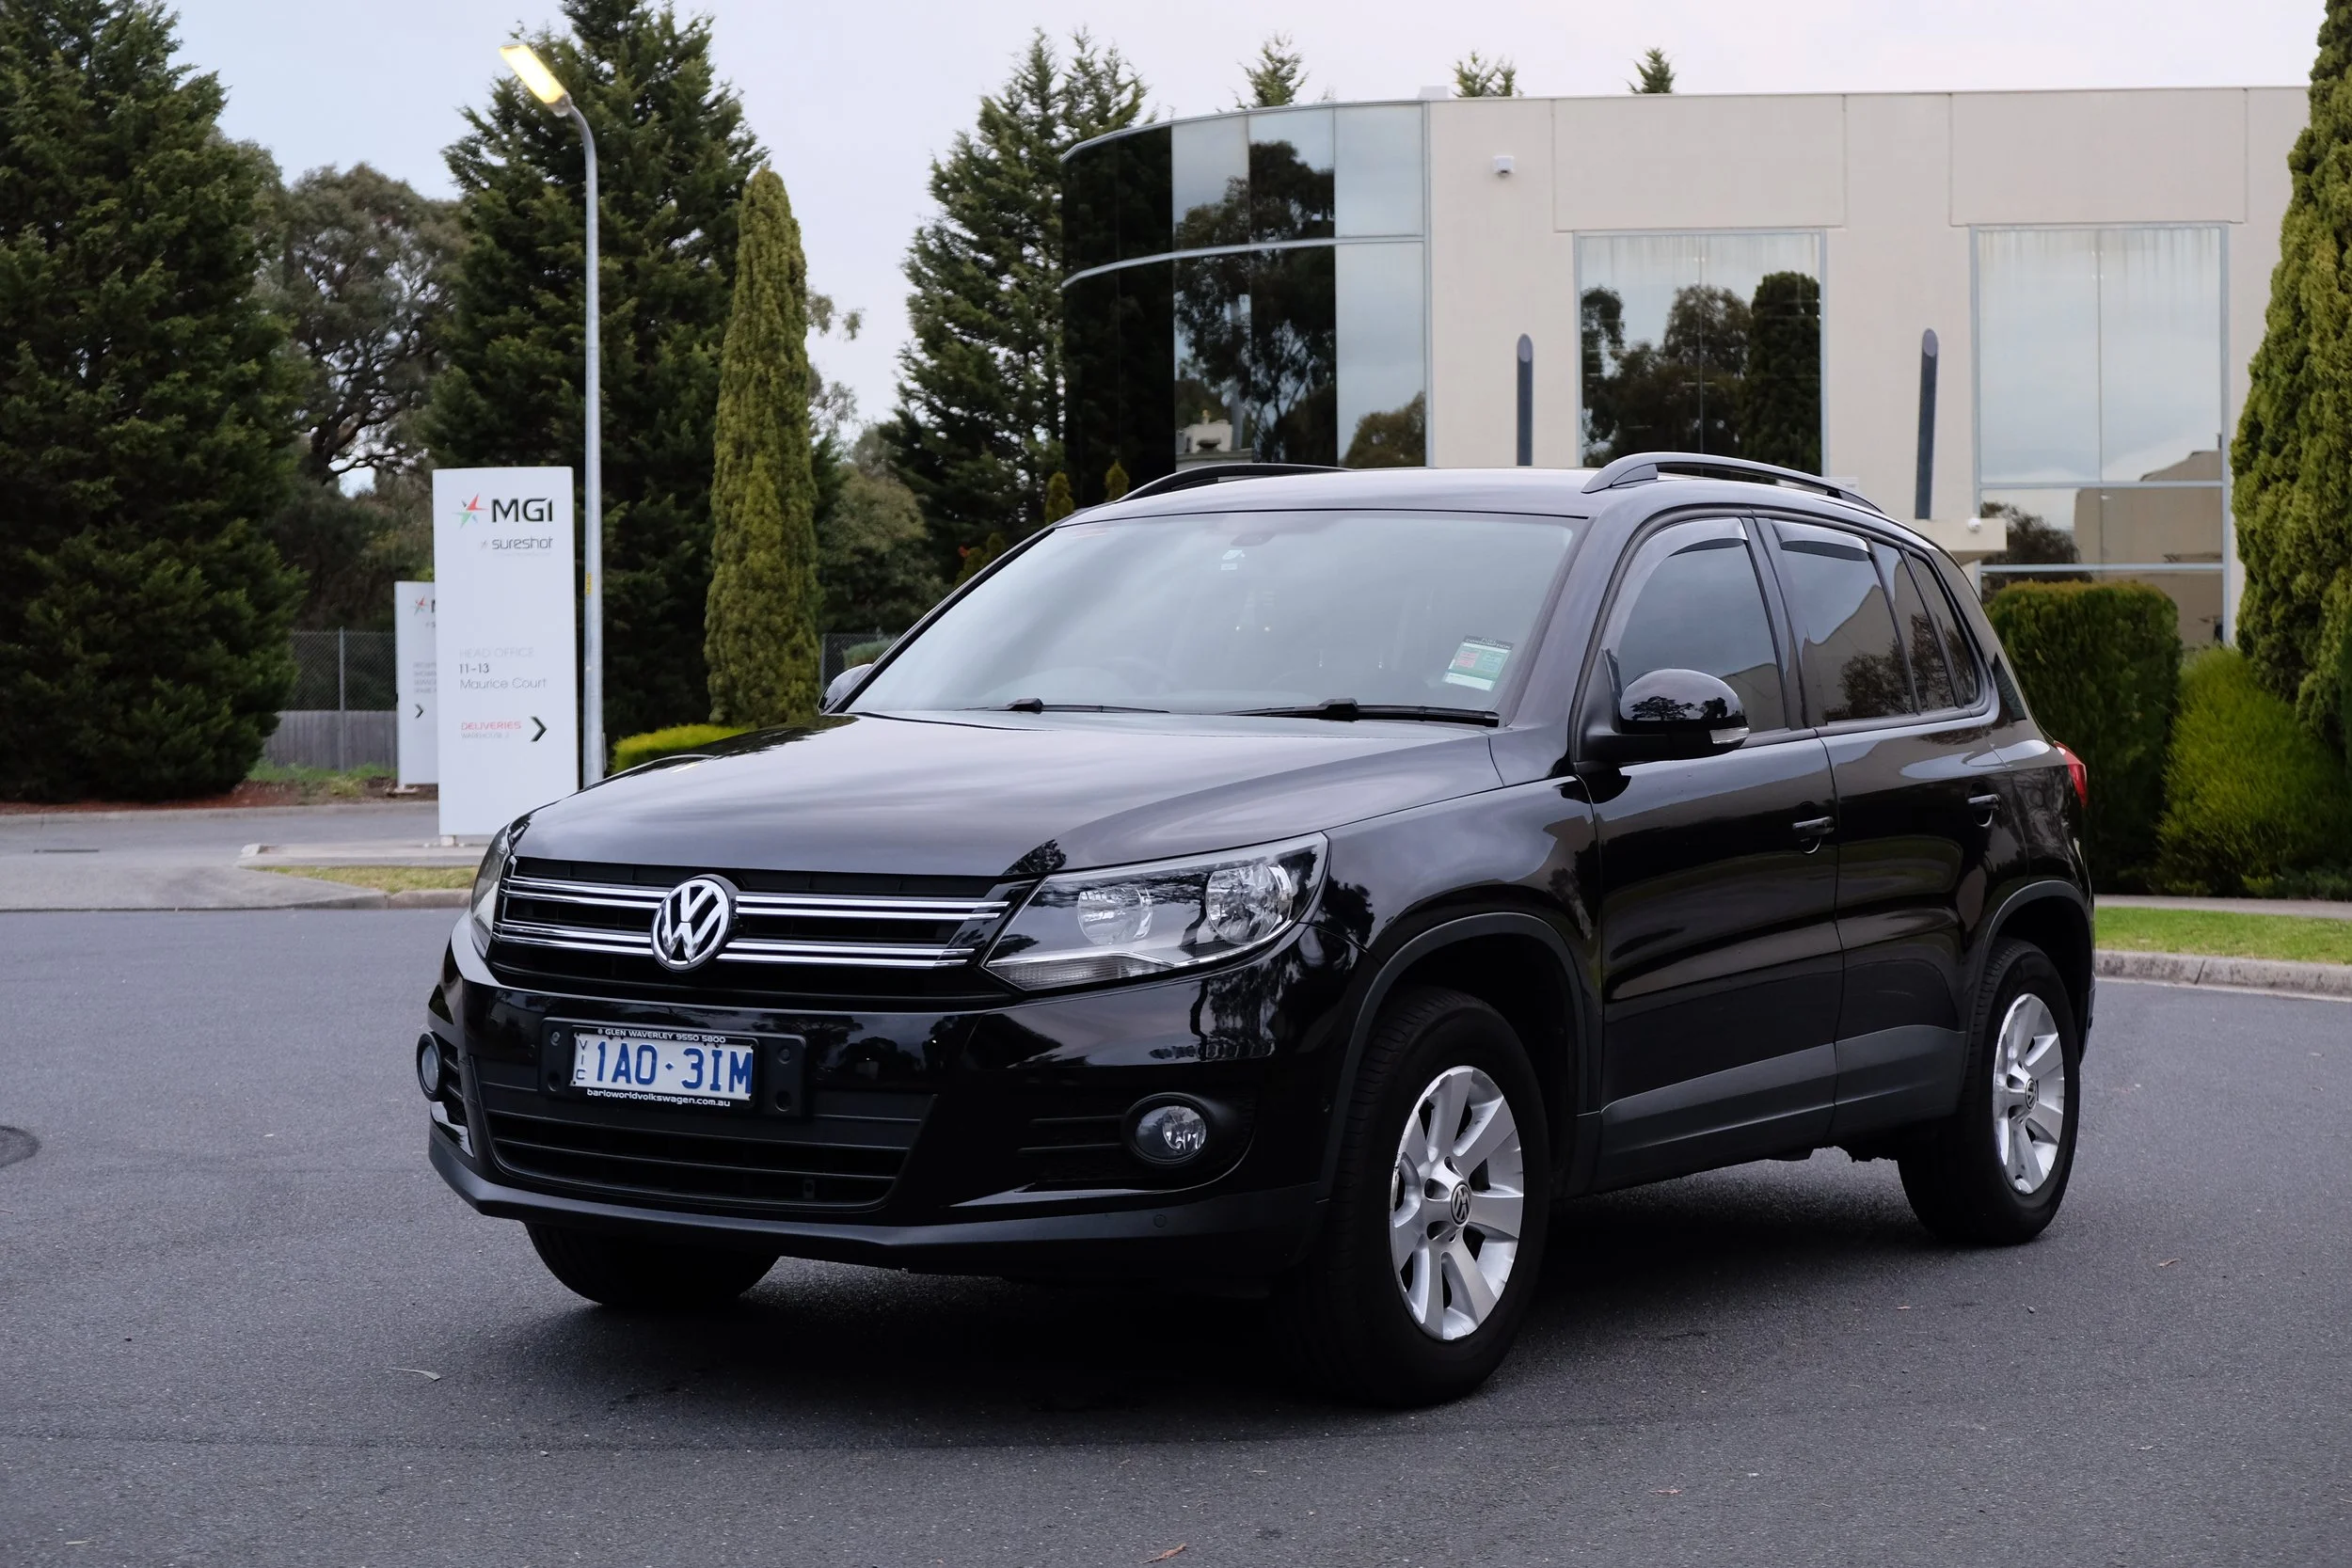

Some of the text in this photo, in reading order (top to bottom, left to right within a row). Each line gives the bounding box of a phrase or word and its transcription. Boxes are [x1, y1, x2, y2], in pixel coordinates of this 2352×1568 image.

[492, 498, 553, 522] MGI
[491, 536, 553, 550] sureshot
[459, 647, 534, 658] HEAD OFFICE
[459, 662, 490, 673] 11-13
[459, 677, 548, 689] Maurice Court
[461, 721, 522, 731] DELIVERIES
[605, 1028, 627, 1037] GLEN
[628, 1030, 674, 1039] WAVERLEY
